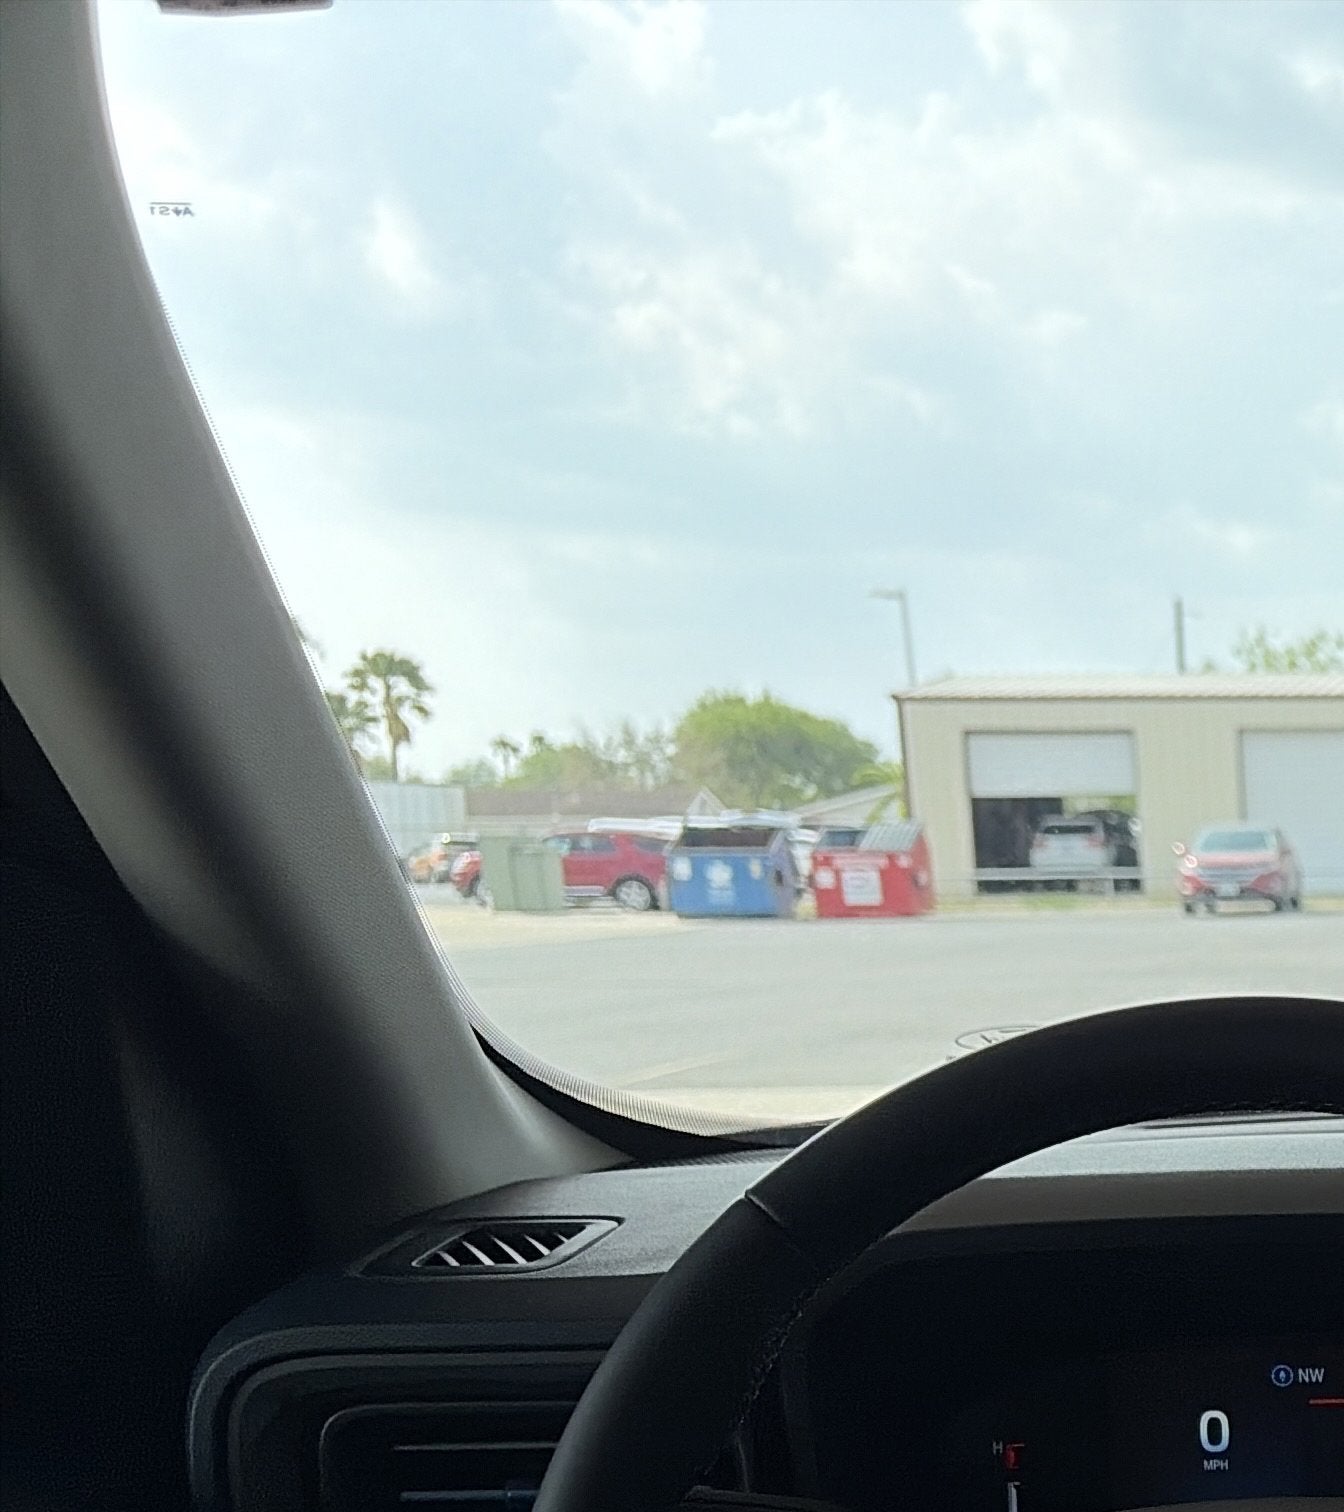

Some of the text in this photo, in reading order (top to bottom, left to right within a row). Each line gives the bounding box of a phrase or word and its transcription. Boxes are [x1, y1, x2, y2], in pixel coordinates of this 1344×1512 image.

[1298, 1366, 1326, 1384] NW
[1199, 1408, 1231, 1453] 0
[1203, 1458, 1229, 1472] MPH
